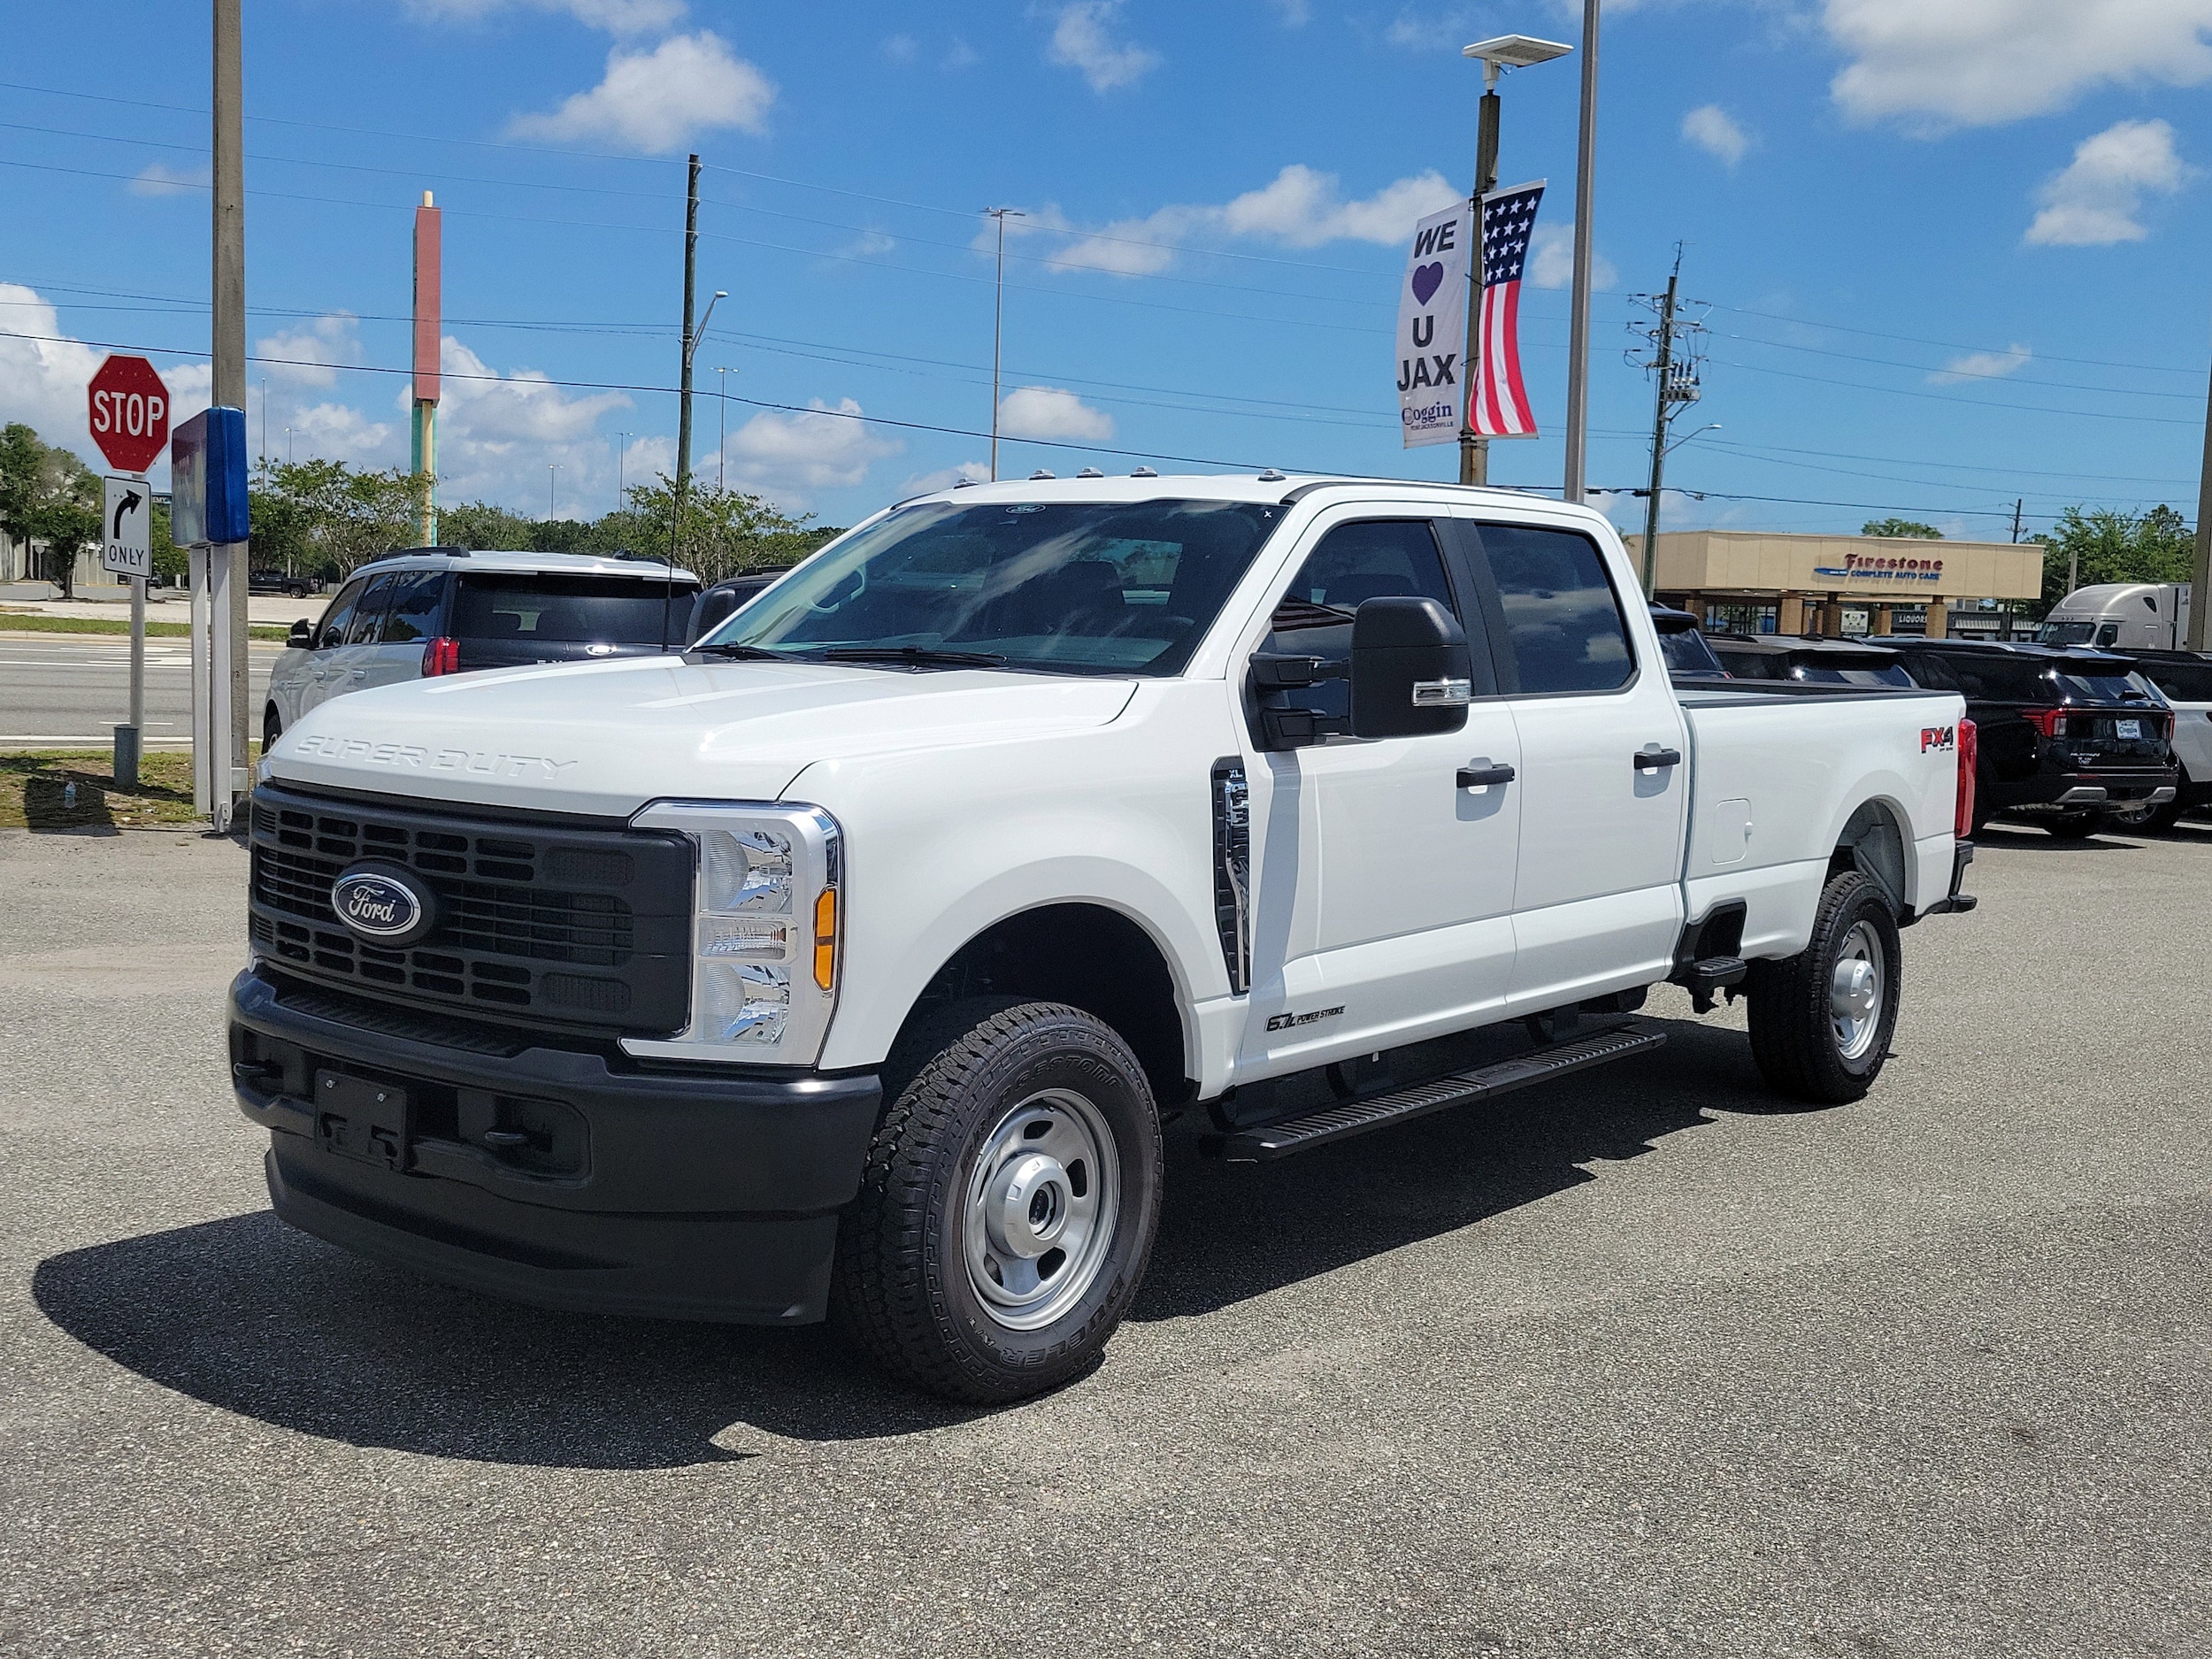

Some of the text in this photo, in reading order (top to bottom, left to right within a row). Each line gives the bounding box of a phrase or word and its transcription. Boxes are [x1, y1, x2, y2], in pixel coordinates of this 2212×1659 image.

[1414, 219, 1457, 258] WE
[1412, 315, 1433, 348] U
[1397, 353, 1456, 391] JAX
[94, 390, 165, 437] STOP
[1402, 402, 1453, 425] Coggin
[109, 545, 145, 567] ONLY
[1845, 553, 1944, 571] Firestone
[1850, 570, 1893, 579] COMPLETE
[1921, 726, 1953, 754] FX4
[295, 735, 579, 780] SUPER DUTY
[1229, 770, 1243, 779] XL
[349, 886, 396, 922] Ford
[1266, 1004, 1346, 1032] 6.7L POWER STROKE
[966, 1316, 995, 1347] A/T
[1000, 1271, 1125, 1367] DUELER
